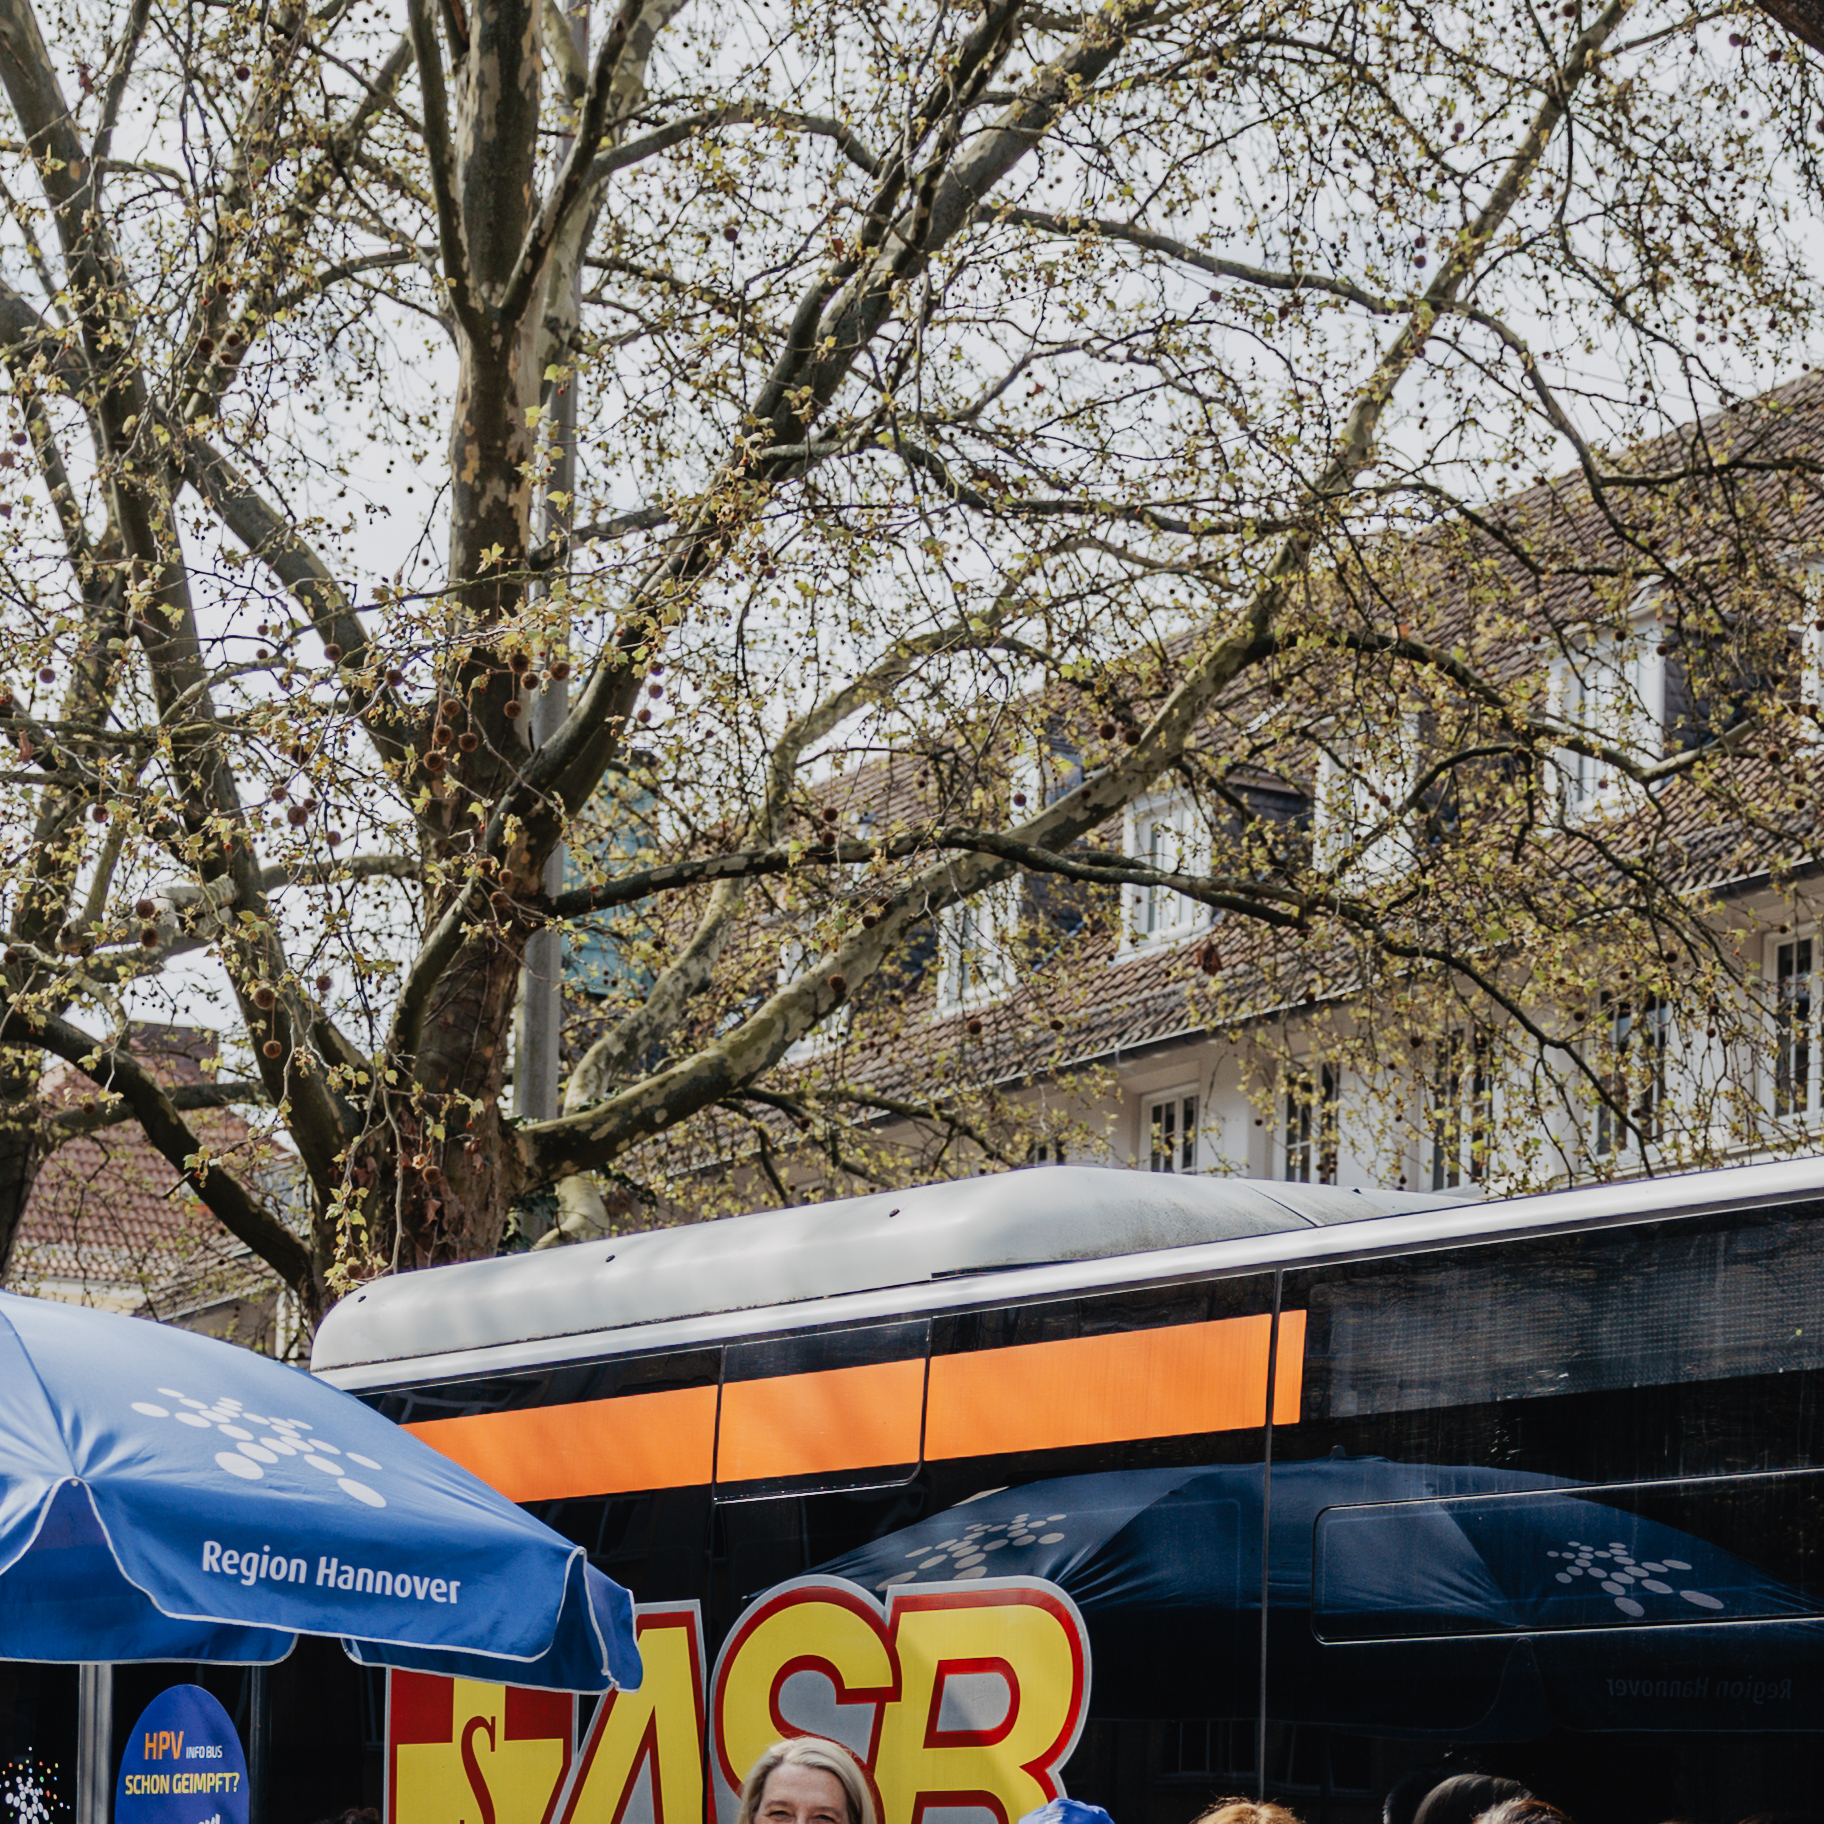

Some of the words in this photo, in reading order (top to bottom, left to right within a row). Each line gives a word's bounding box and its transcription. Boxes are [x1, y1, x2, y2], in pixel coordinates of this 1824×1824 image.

[201, 1539, 308, 1586] Region
[316, 1556, 461, 1605] Hannover
[144, 1731, 184, 1760] HPV
[186, 1746, 205, 1759] INFO
[206, 1745, 223, 1758] BUS
[125, 1774, 170, 1795] SCHON
[172, 1772, 240, 1794] GEIMPFT?
